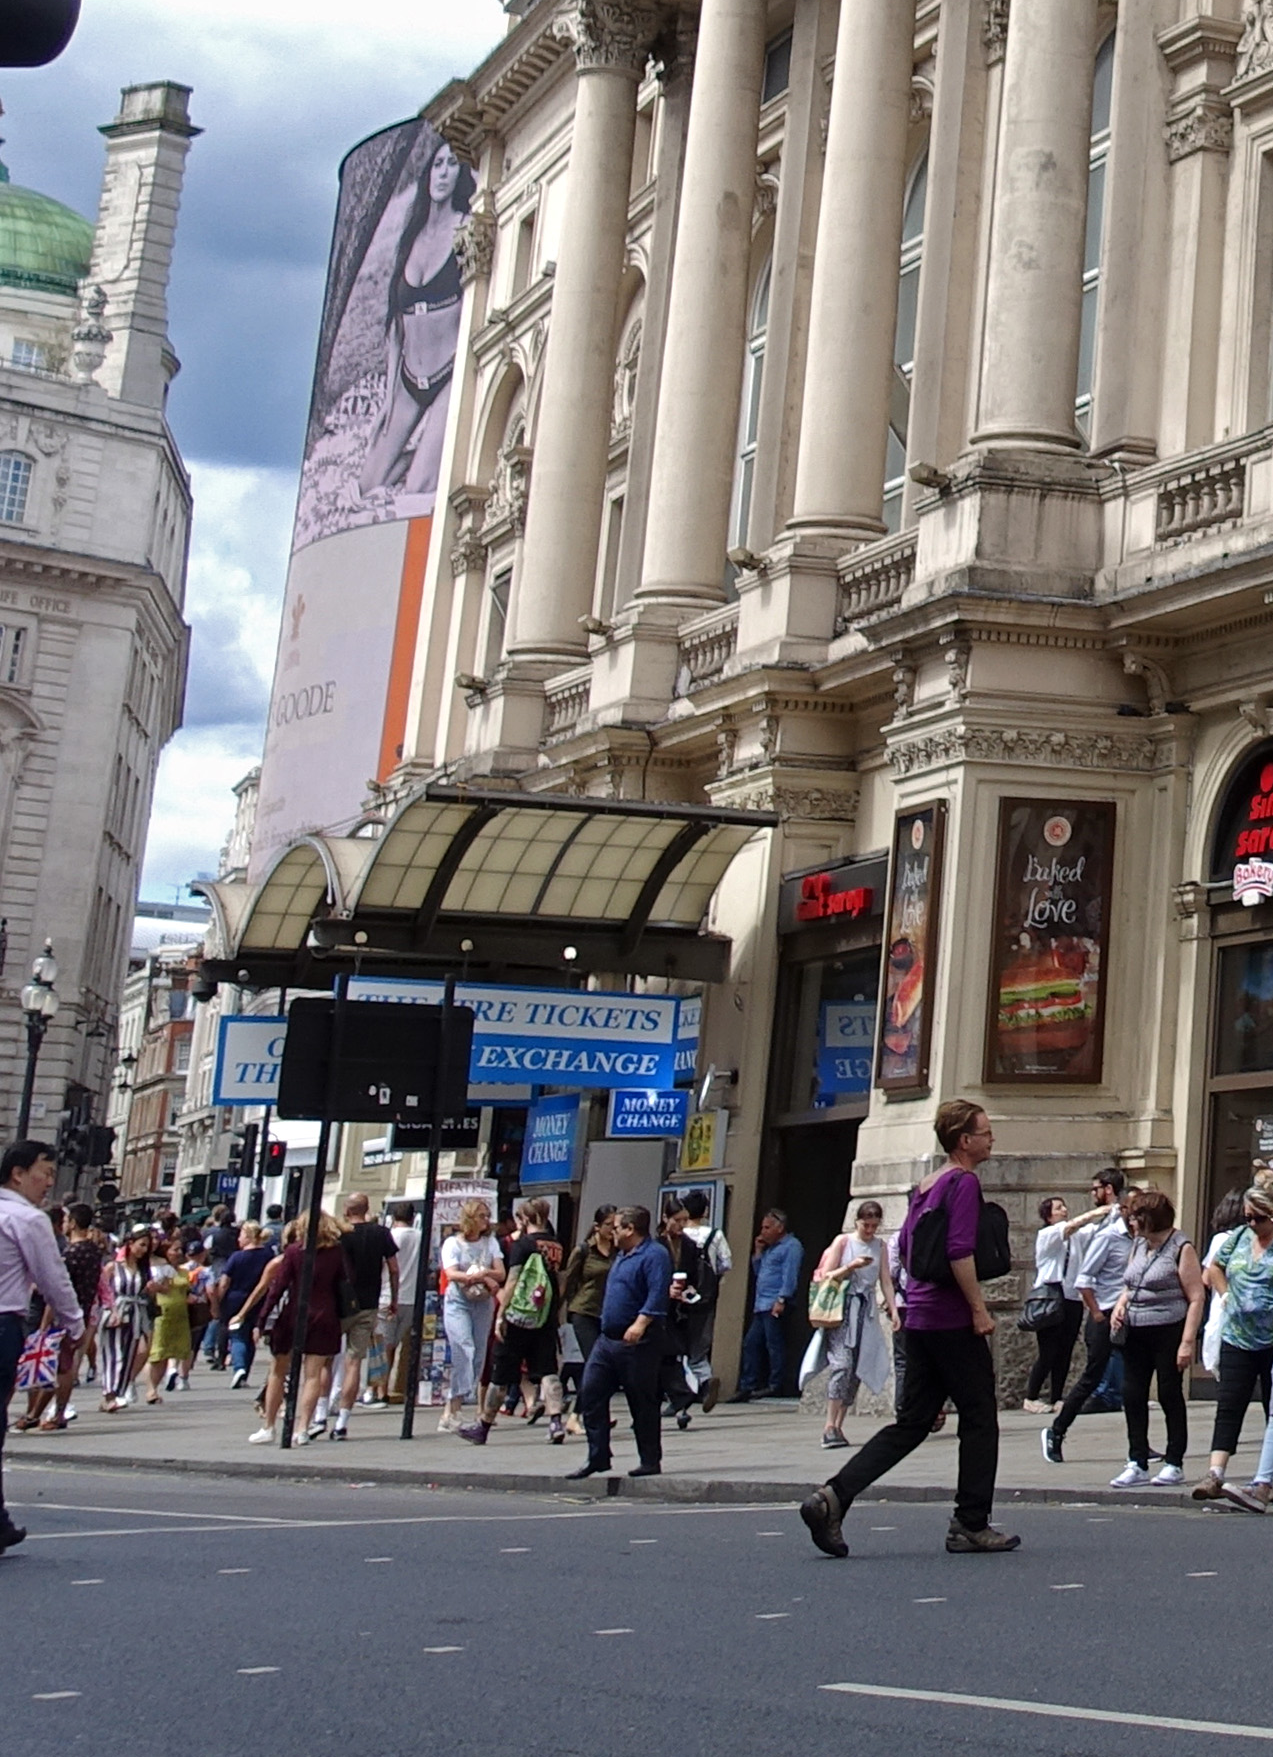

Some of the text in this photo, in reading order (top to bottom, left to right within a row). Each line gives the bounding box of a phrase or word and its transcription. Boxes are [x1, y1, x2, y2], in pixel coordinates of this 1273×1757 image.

[29, 594, 71, 614] OFFICE
[1022, 854, 1086, 886] Baked
[1023, 886, 1077, 929] Love
[525, 1002, 662, 1031] TICKETS
[476, 1045, 661, 1076] EXCHANGE
[621, 1097, 681, 1113] MONEY
[532, 1113, 571, 1138] MONEY
[615, 1113, 682, 1129] CHANGE
[527, 1140, 570, 1165] CHANGE
